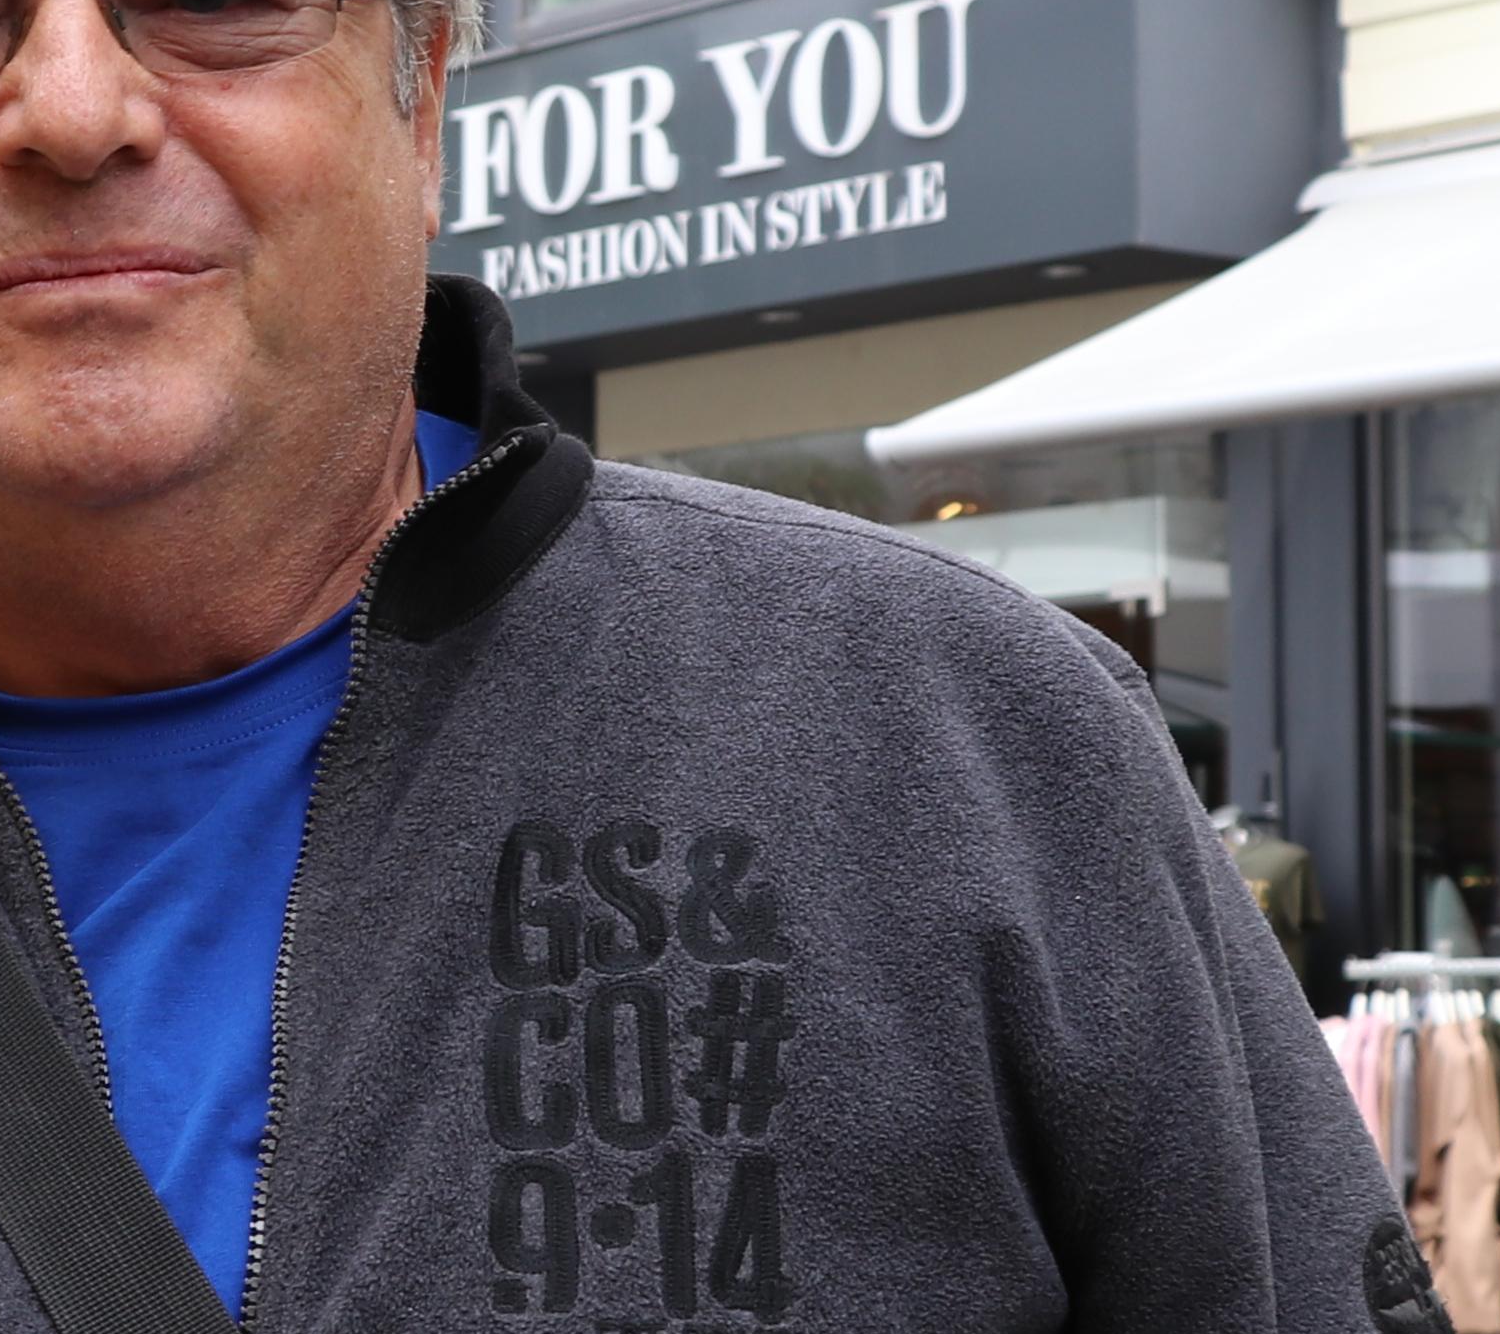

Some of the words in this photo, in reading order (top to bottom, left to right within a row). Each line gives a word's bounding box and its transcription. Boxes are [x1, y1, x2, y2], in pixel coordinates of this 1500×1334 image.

[448, 64, 679, 234] FOR
[482, 210, 692, 301] FASHION
[699, 196, 760, 267] IN
[765, 160, 949, 253] STYLE
[489, 818, 795, 991] GS&
